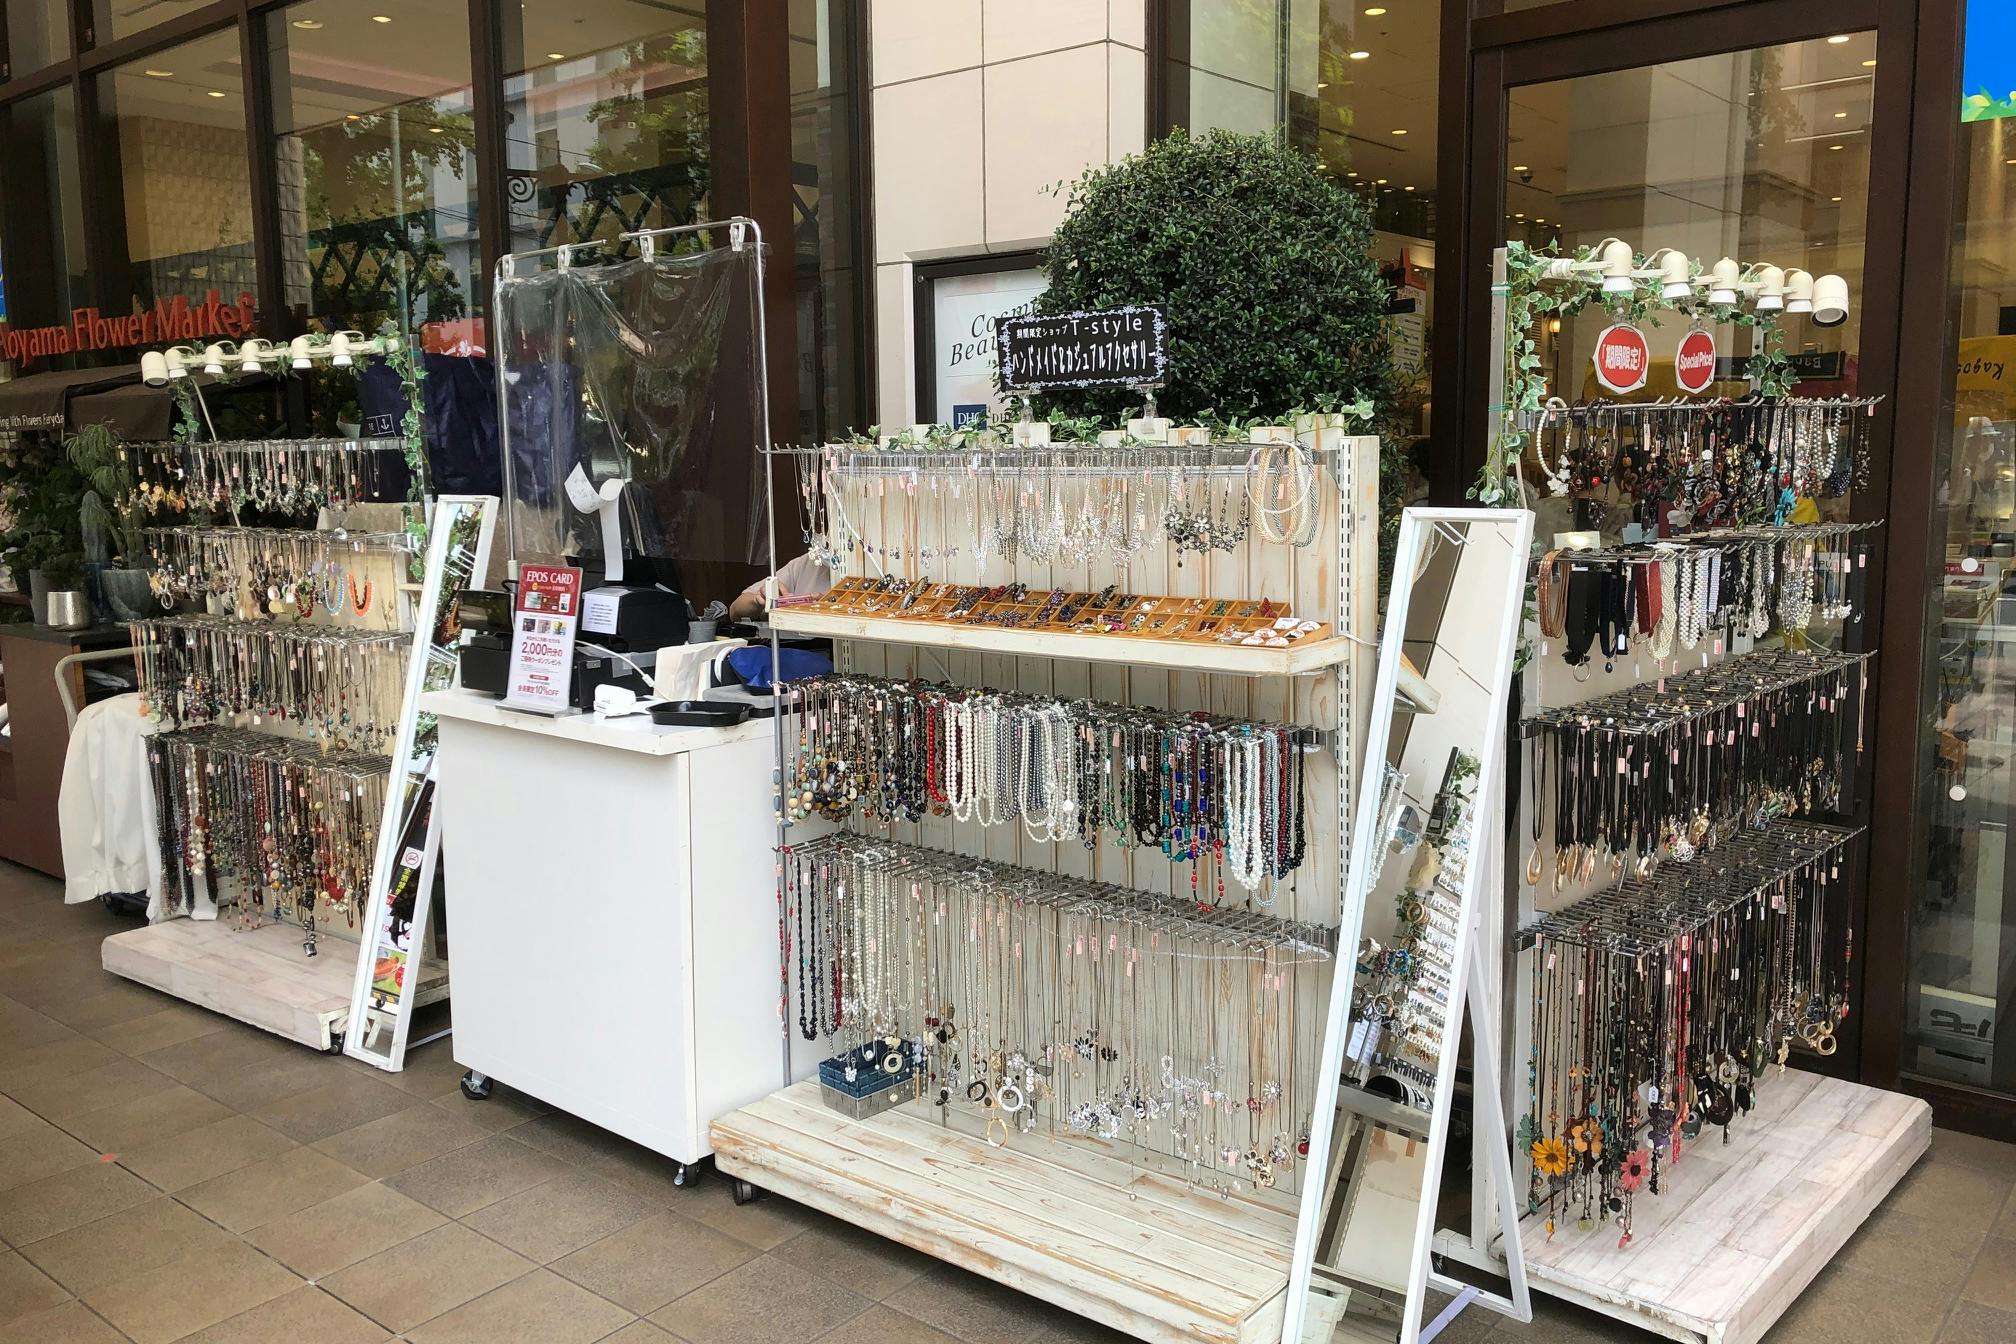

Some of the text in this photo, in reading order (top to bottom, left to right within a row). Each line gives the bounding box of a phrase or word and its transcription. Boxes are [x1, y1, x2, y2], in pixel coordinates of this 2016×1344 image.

[72, 307, 153, 350] Flower
[155, 288, 257, 341] Market
[1680, 351, 1700, 371] Special
[527, 570, 574, 584] EPOS CARD
